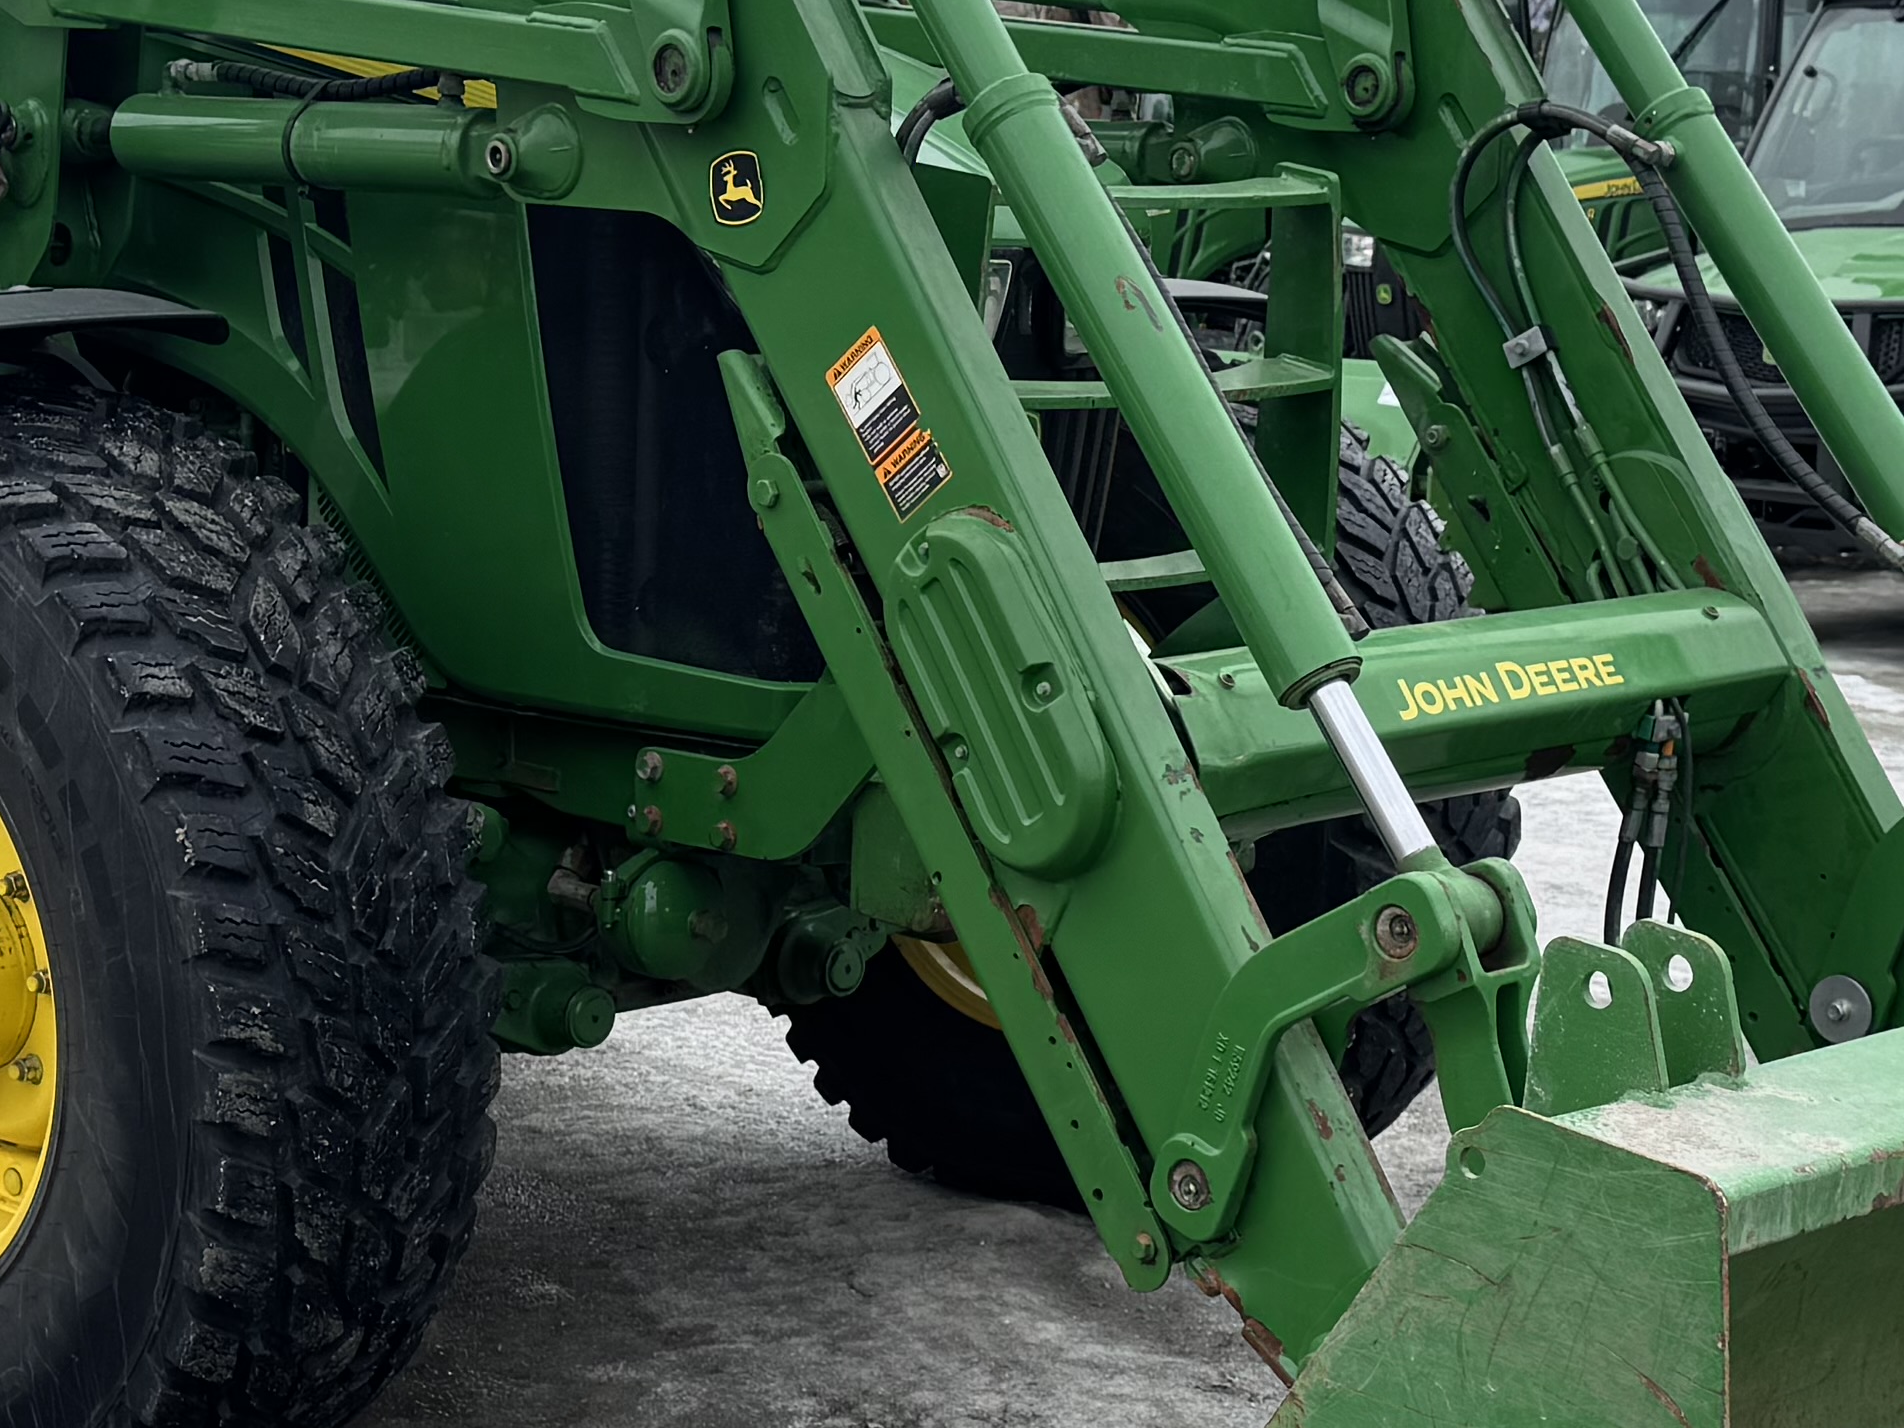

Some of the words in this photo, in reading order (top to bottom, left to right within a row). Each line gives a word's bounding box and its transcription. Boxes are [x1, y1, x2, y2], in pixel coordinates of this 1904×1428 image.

[839, 334, 874, 372] WARNING
[890, 432, 927, 469] WARNING
[1397, 671, 1500, 721] JOHN
[1495, 653, 1625, 700] DEERE
